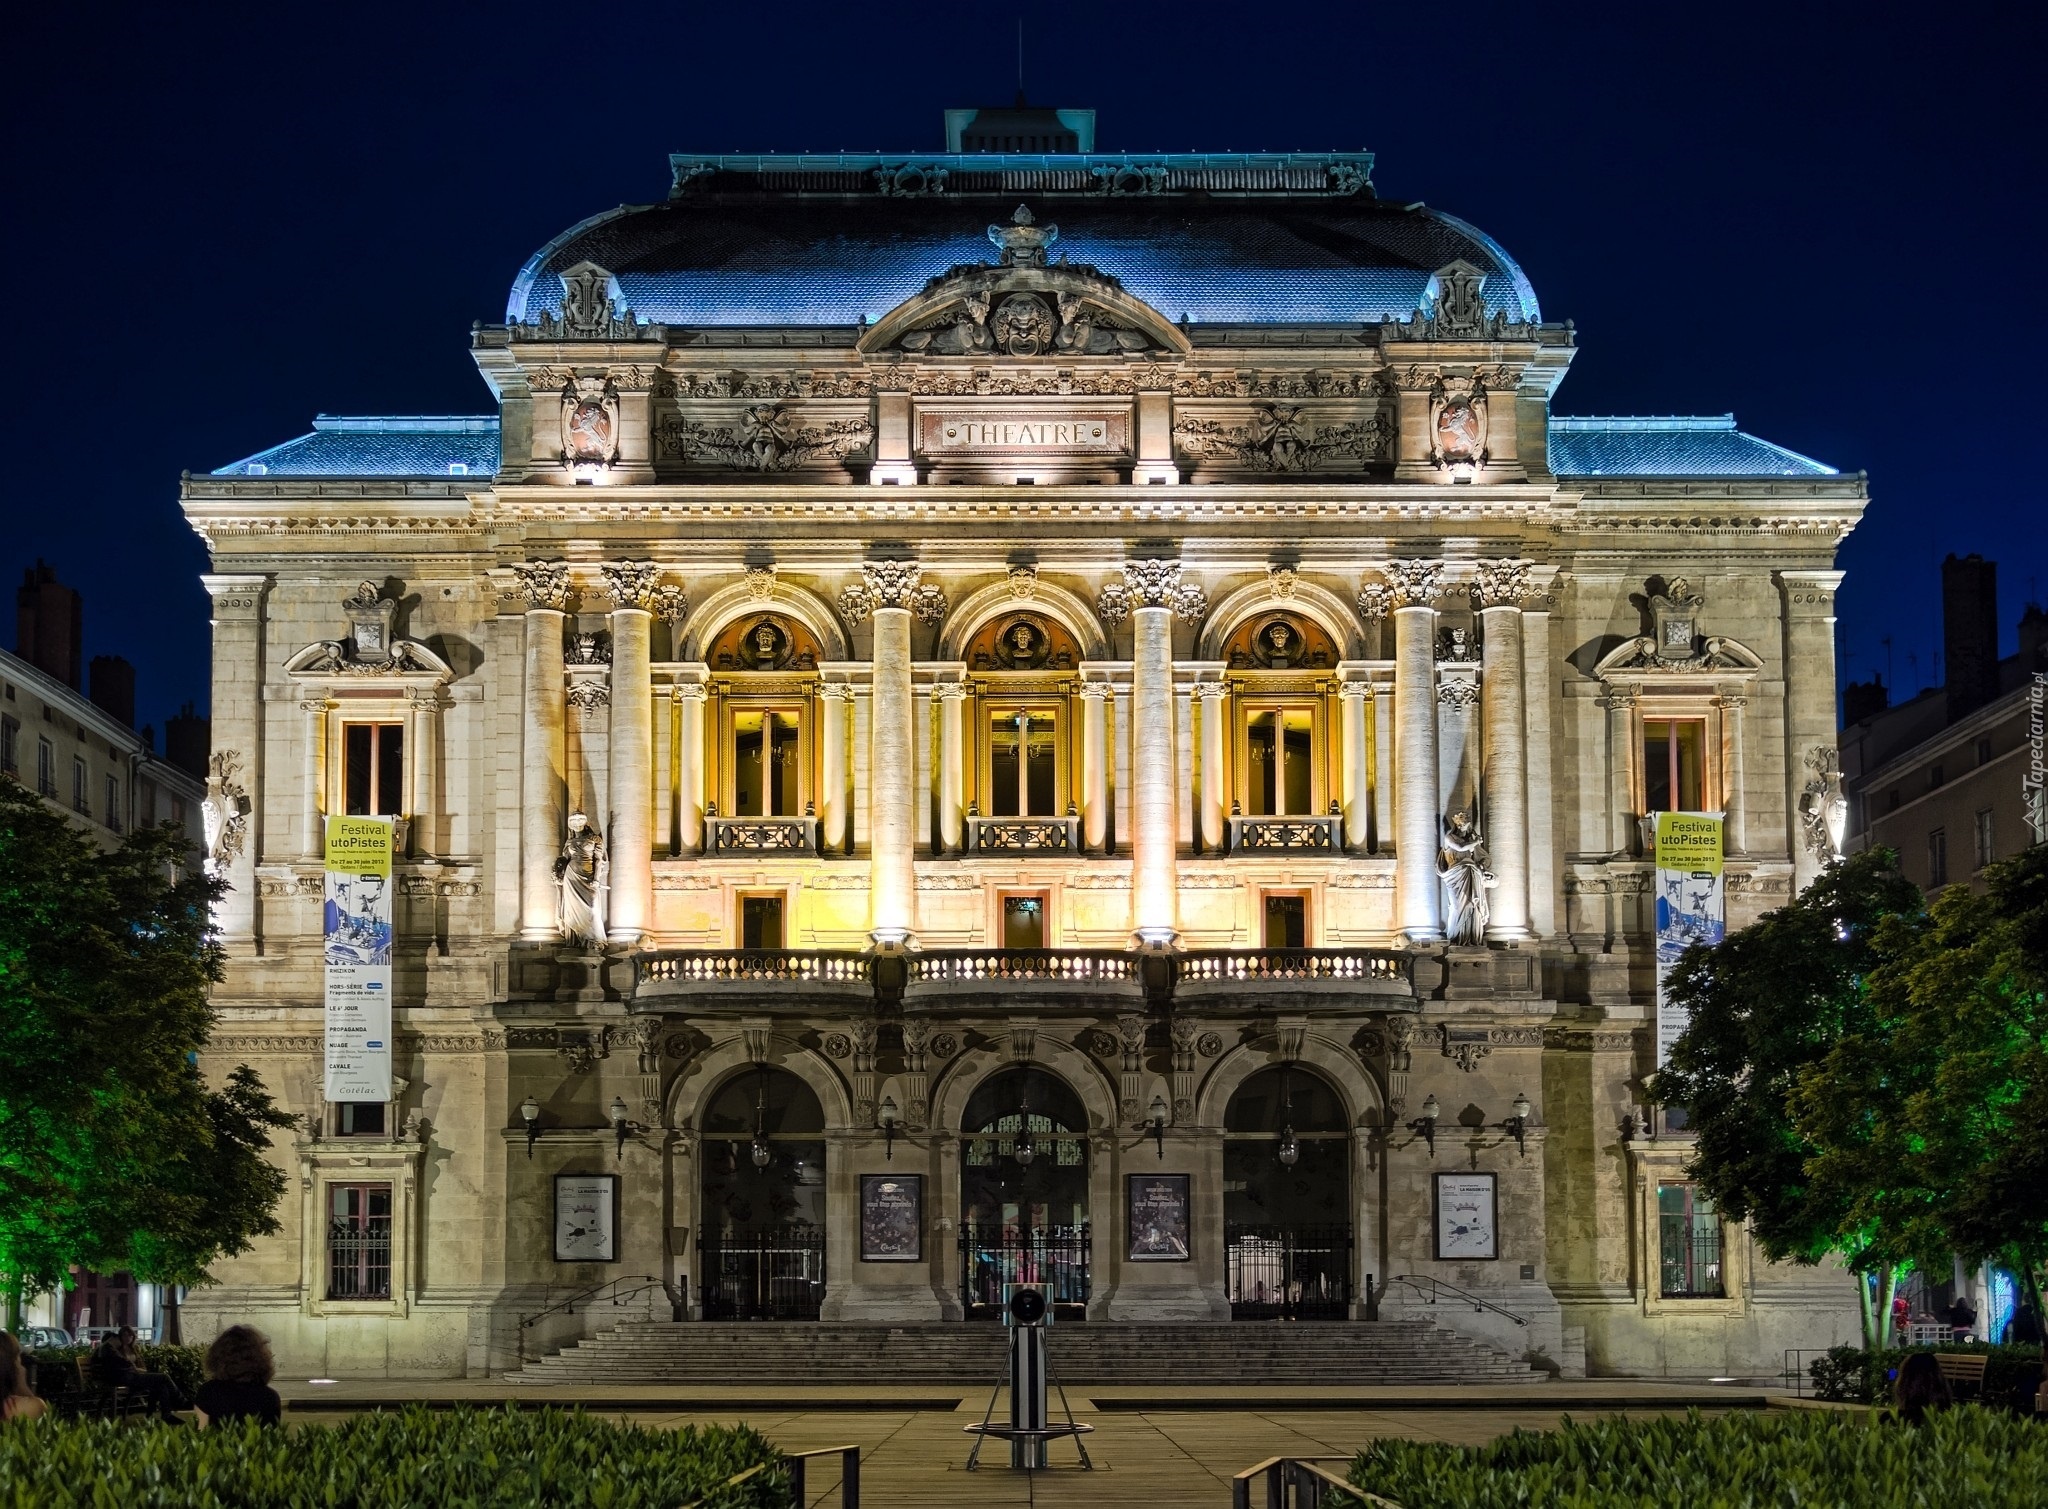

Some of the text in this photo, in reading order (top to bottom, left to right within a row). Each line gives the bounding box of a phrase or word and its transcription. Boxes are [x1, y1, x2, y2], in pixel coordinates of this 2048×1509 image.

[961, 423, 1087, 444] THEATRE
[342, 824, 386, 834] Festival
[1672, 822, 1716, 832] Festival
[331, 838, 386, 847] utoPistes
[1662, 834, 1716, 844] utoPistes
